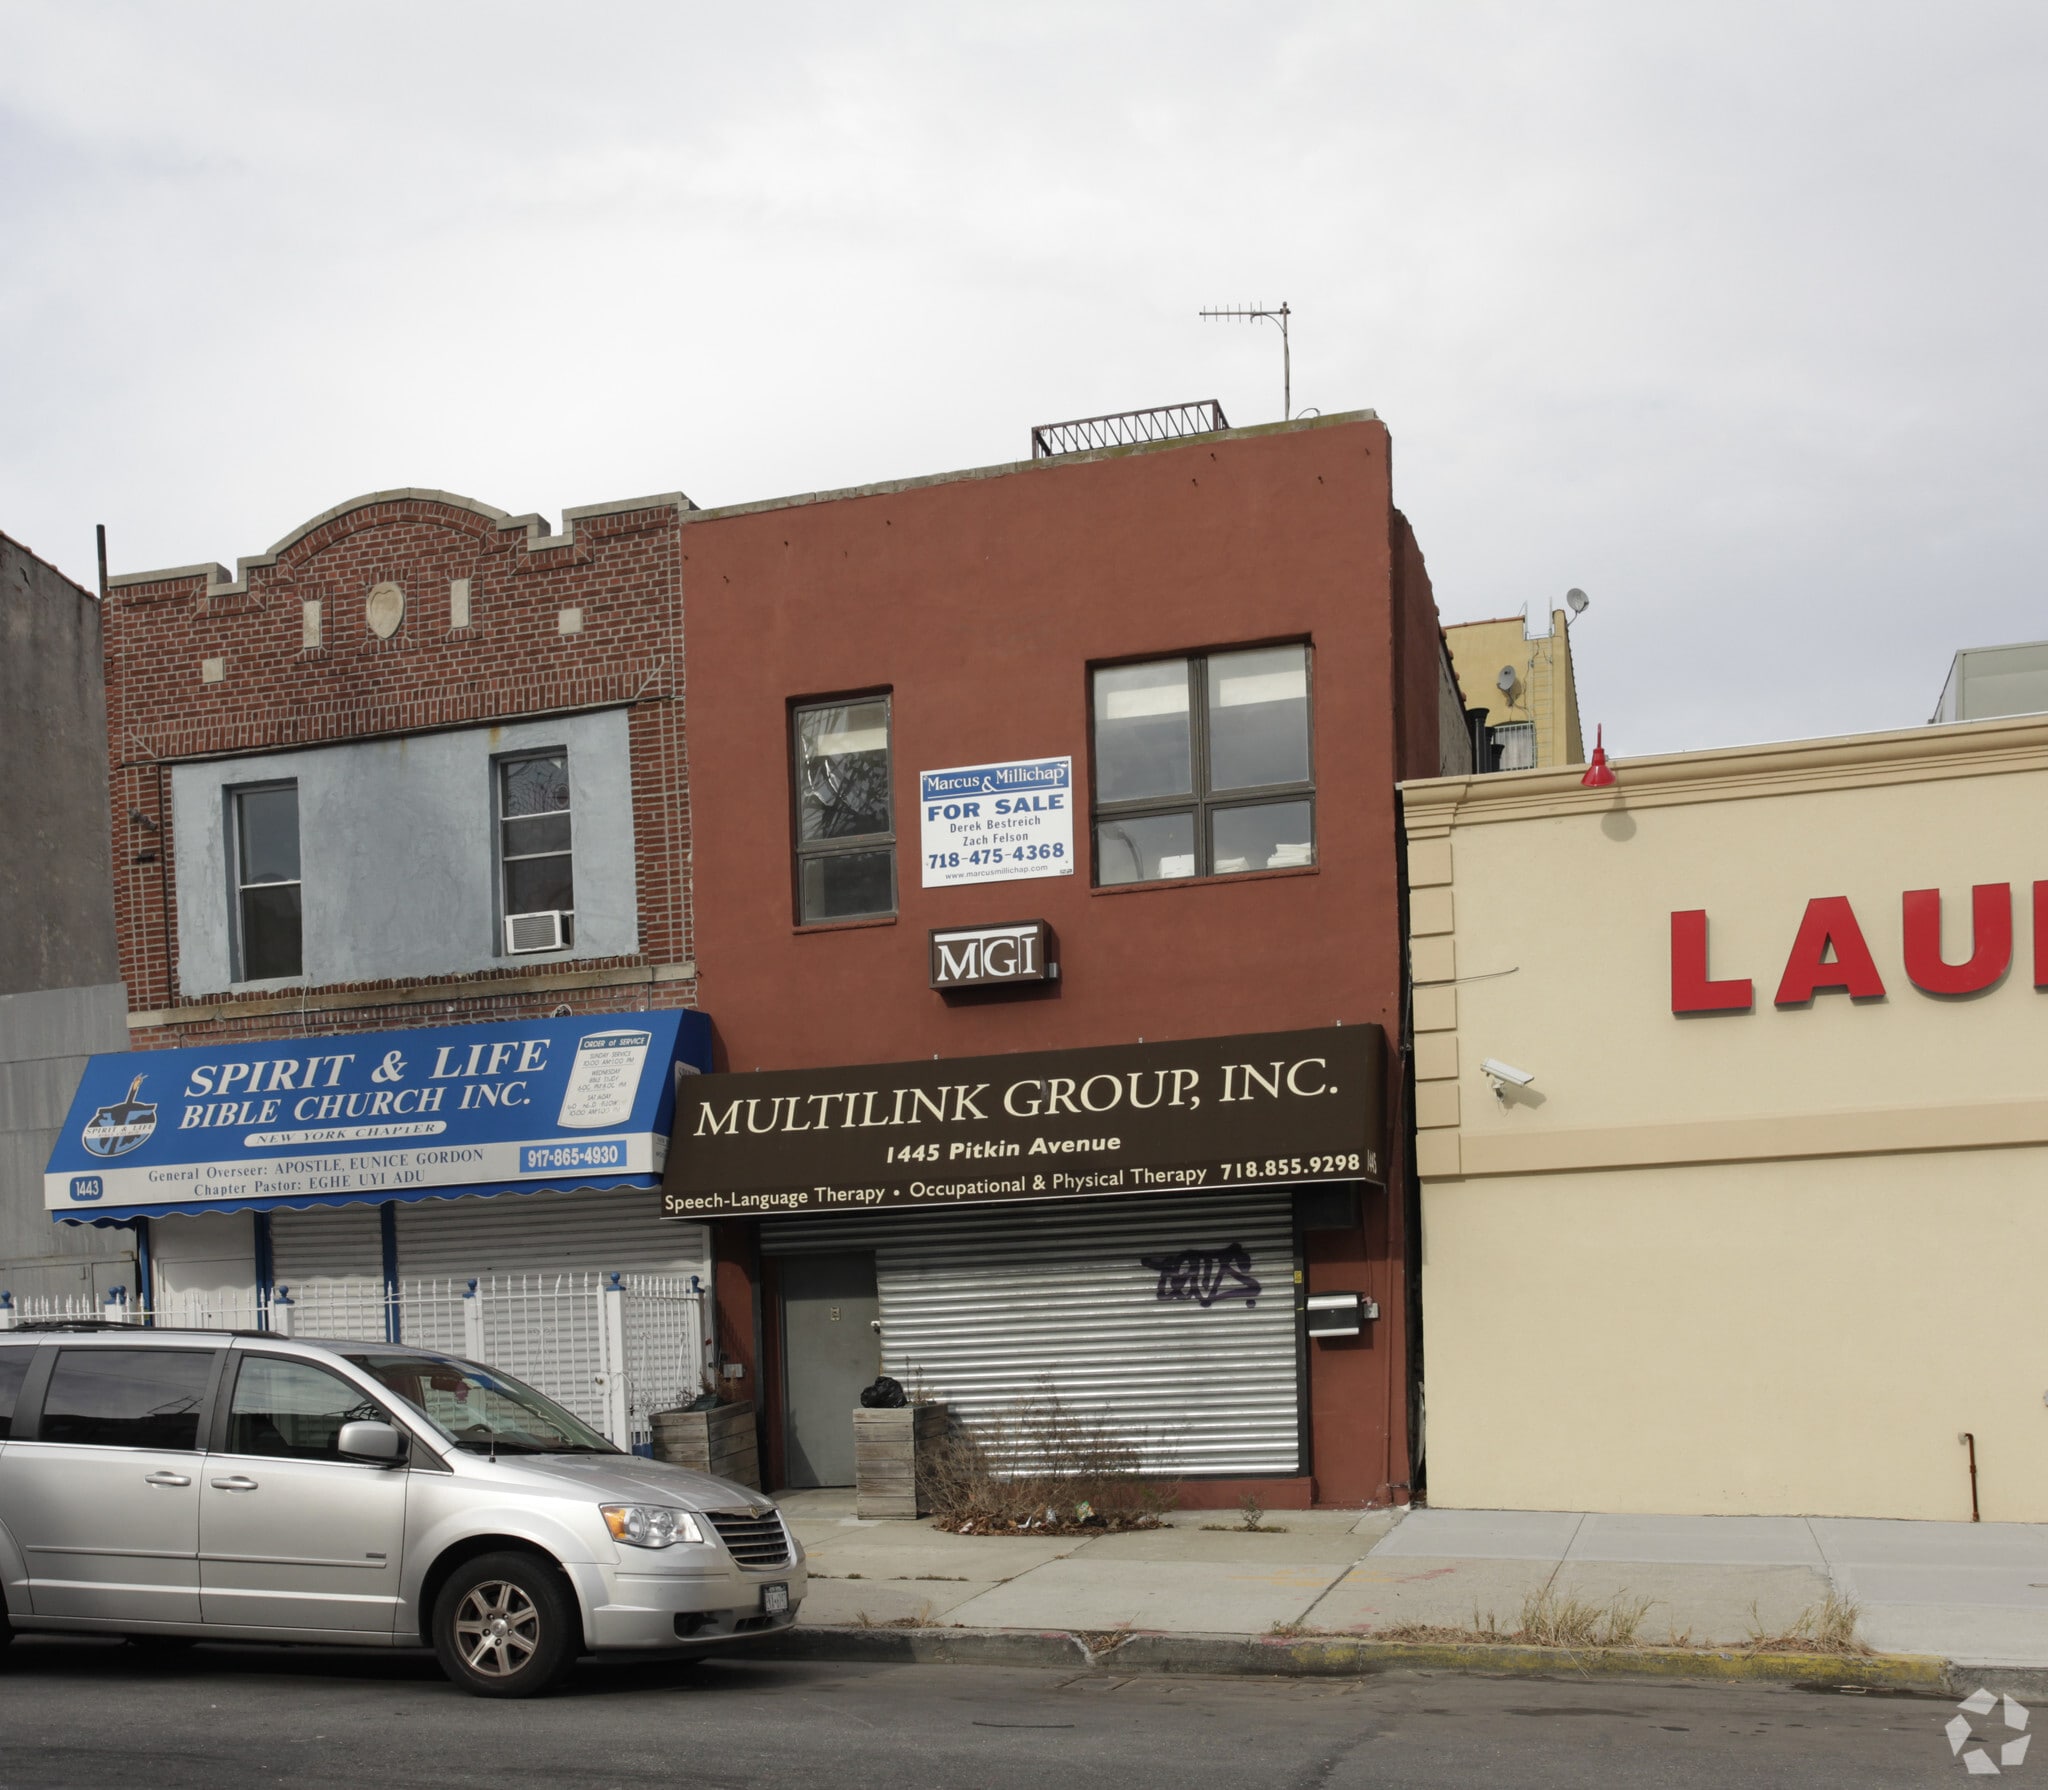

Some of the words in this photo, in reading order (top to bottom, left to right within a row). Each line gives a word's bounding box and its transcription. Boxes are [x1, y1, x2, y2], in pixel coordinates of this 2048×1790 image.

[928, 776, 980, 791] Marcus
[982, 776, 997, 793] &
[996, 766, 1065, 786] Millichap
[928, 802, 980, 822] FOR
[995, 794, 1064, 815] SALE
[950, 817, 982, 833] Derek
[987, 815, 1041, 830] Bestreich
[963, 834, 988, 847] Zach
[993, 832, 1029, 845] Felson
[929, 842, 1065, 869] 718-475-4368
[945, 864, 1048, 880] www.marcusmillichap.com
[937, 936, 1037, 981] MGI
[1671, 879, 2048, 1012] LAU
[584, 1040, 606, 1048] ORDER
[619, 1037, 645, 1046] SERVICE
[184, 1053, 356, 1098] SPIRIT
[371, 1050, 408, 1083] &
[428, 1039, 551, 1079] LIFE
[177, 1098, 281, 1130] BIBLE
[294, 1087, 447, 1121] CHURCH
[457, 1081, 531, 1110] INC.
[693, 1083, 990, 1136] MULTILINK
[1003, 1068, 1200, 1117] GROUP,
[1219, 1058, 1338, 1102] INC.
[256, 1133, 296, 1144] NEW
[302, 1129, 347, 1141] YORK
[355, 1124, 436, 1138] CHAPTER
[528, 1145, 618, 1168] 917-865-4930
[886, 1143, 940, 1163] 1445
[949, 1140, 1020, 1160] Pitkin
[1028, 1137, 1121, 1156] Avenue
[148, 1168, 199, 1182] General
[206, 1165, 268, 1179] Overseer:
[274, 1158, 345, 1175] APOSTLE,
[350, 1153, 409, 1170] EUNICE
[416, 1149, 484, 1165] GORDON
[75, 1180, 99, 1197] 1443
[194, 1183, 247, 1197] Chapter
[255, 1180, 301, 1193] Pastor:
[309, 1174, 351, 1190] EGHE
[359, 1172, 386, 1186] UYI
[393, 1170, 425, 1184] ADU
[665, 1191, 808, 1214] Speech-Language
[814, 1187, 885, 1205] Therapy
[909, 1176, 1025, 1199] Occupational
[1032, 1174, 1046, 1190] &
[1053, 1169, 1123, 1192] Physical
[1130, 1167, 1207, 1186] Therapy
[1220, 1153, 1360, 1181] 718.855.9298
